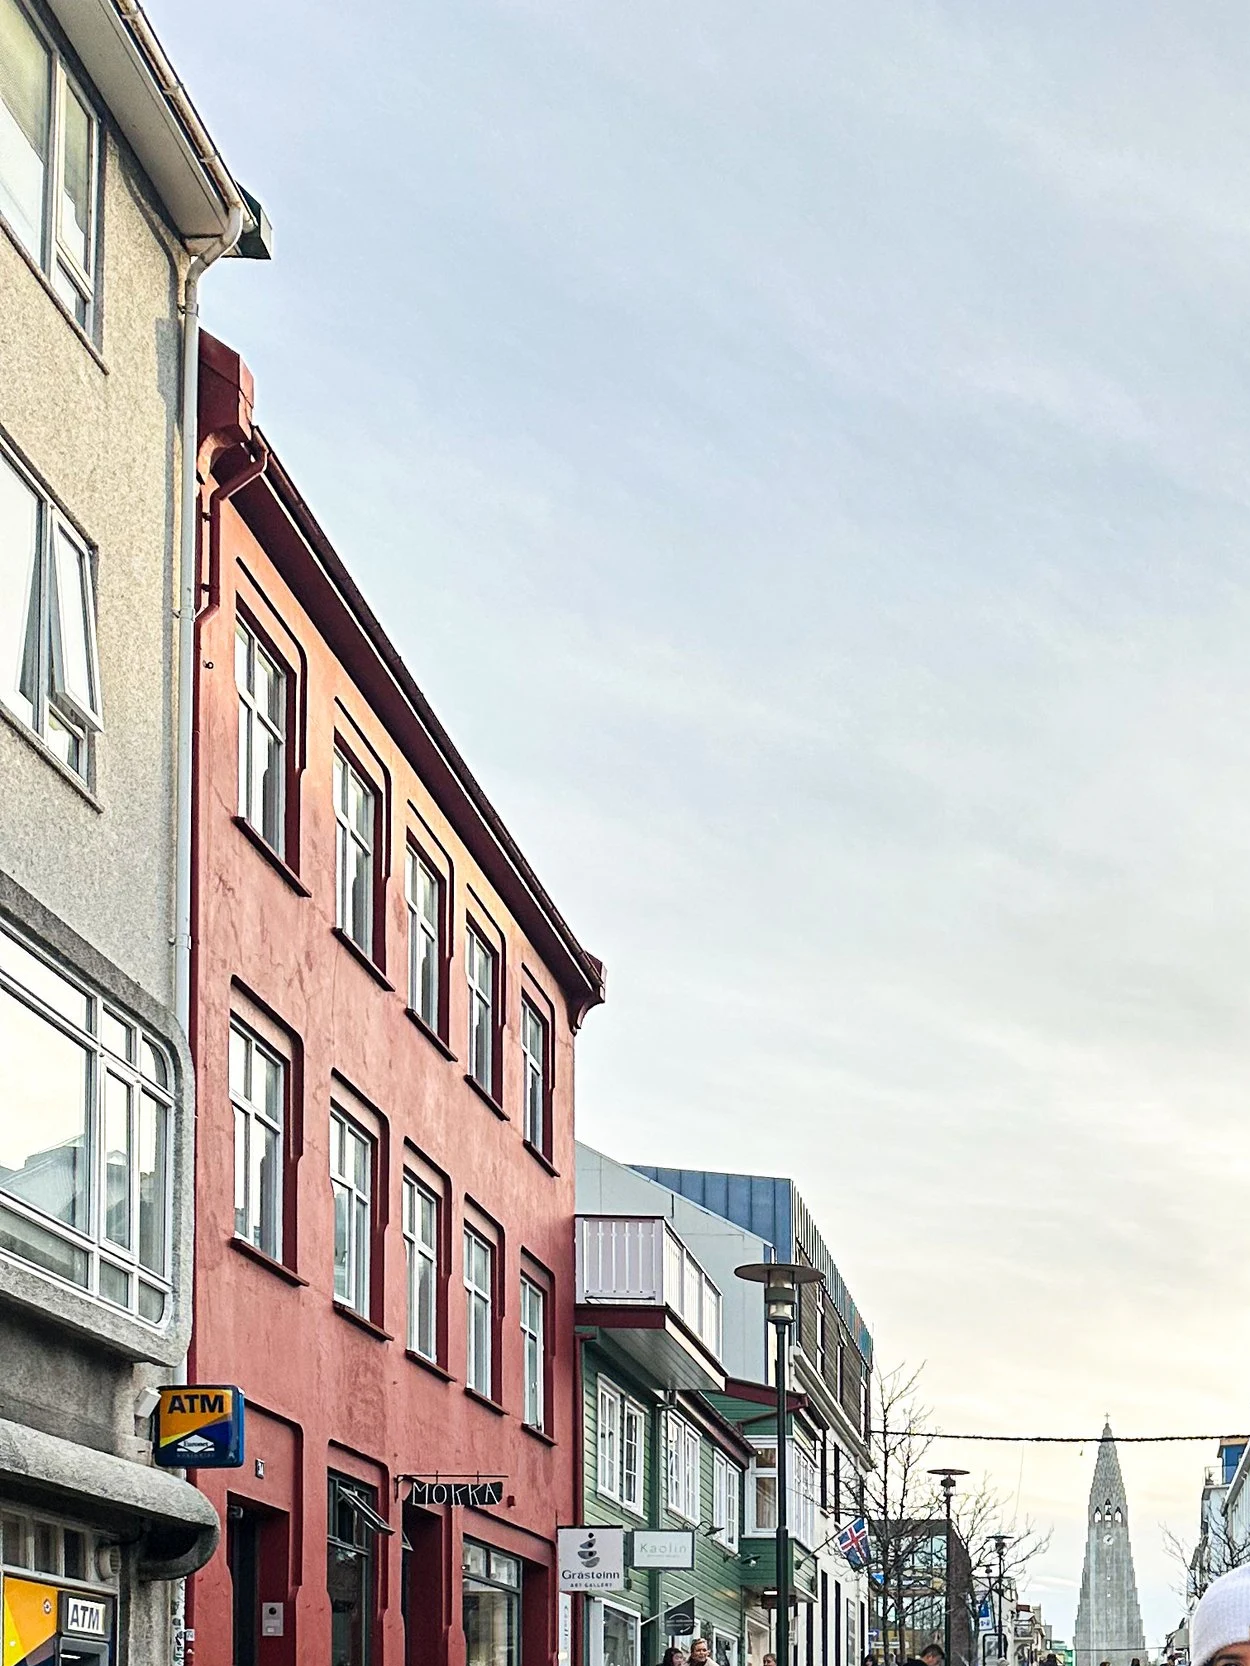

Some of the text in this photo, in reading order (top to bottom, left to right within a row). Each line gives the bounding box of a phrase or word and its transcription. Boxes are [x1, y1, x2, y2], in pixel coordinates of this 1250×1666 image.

[168, 1395, 224, 1414] ATM
[183, 1440, 209, 1448] Euronet
[412, 1482, 500, 1508] MOKKA
[640, 1543, 687, 1554] Kaolin
[70, 1604, 99, 1631] ATM
